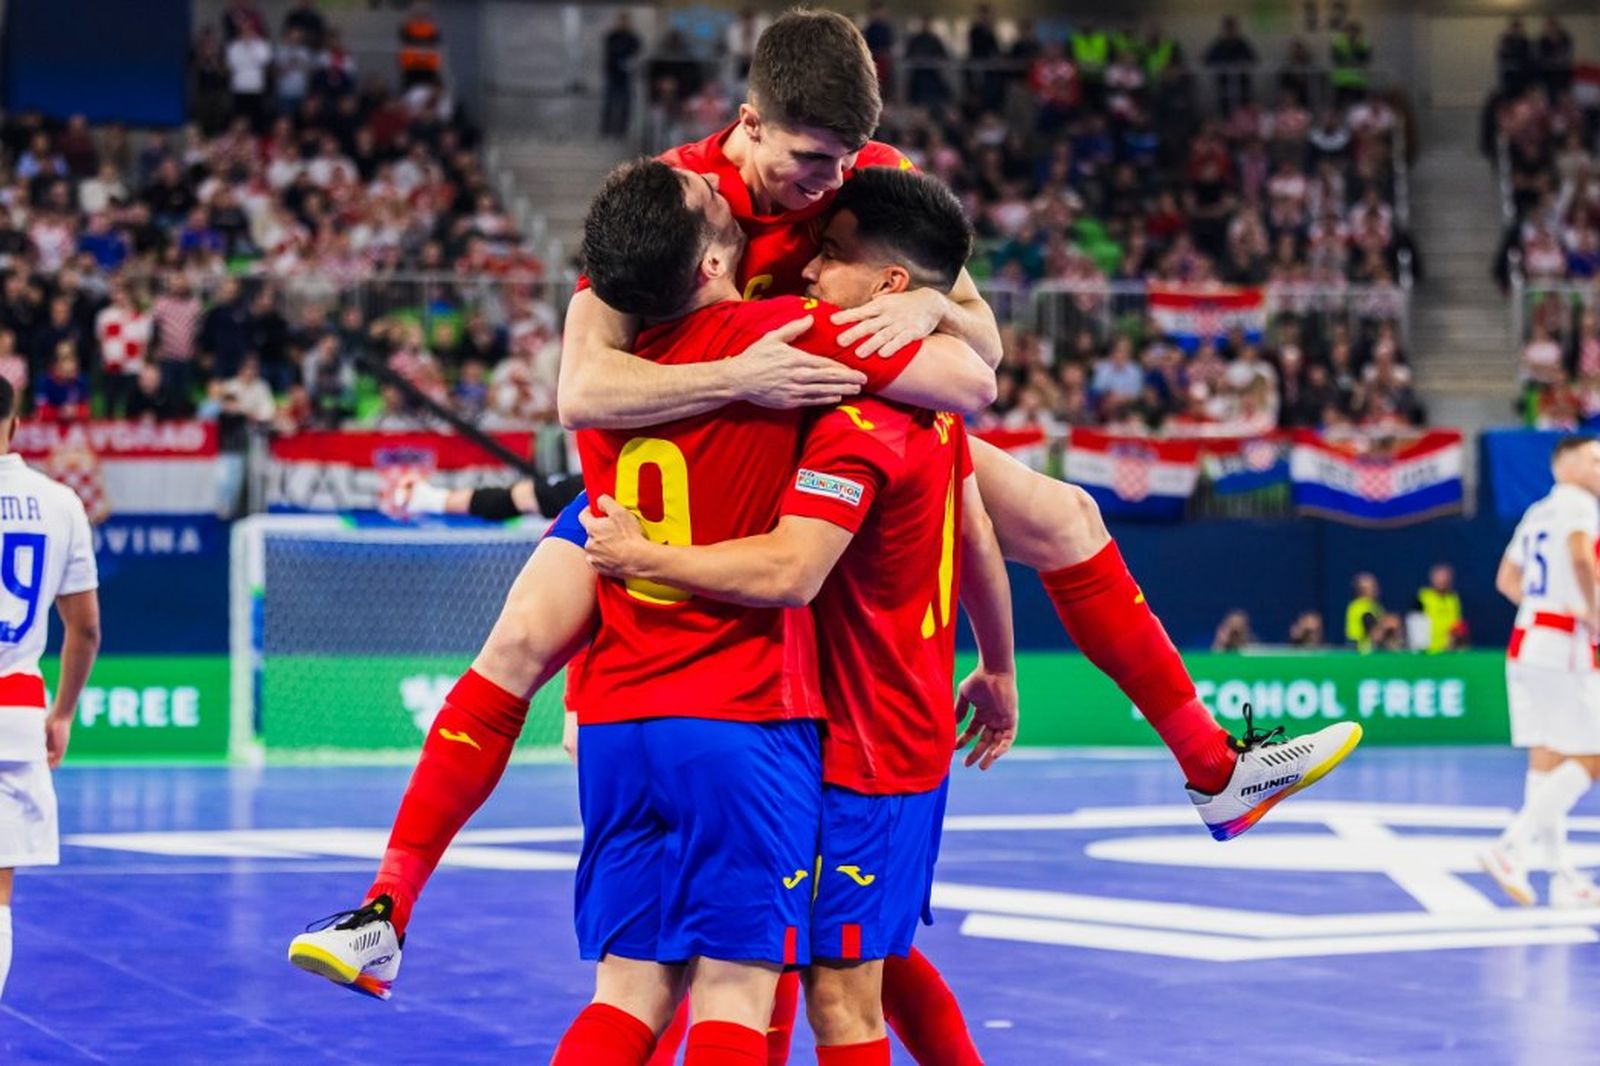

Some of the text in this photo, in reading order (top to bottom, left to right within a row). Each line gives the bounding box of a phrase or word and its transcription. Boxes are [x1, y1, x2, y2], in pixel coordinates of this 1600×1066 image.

[615, 437, 692, 605] 9
[1, 532, 47, 643] 9
[79, 686, 200, 728] FREE
[1131, 679, 1466, 719] COHOL FREE
